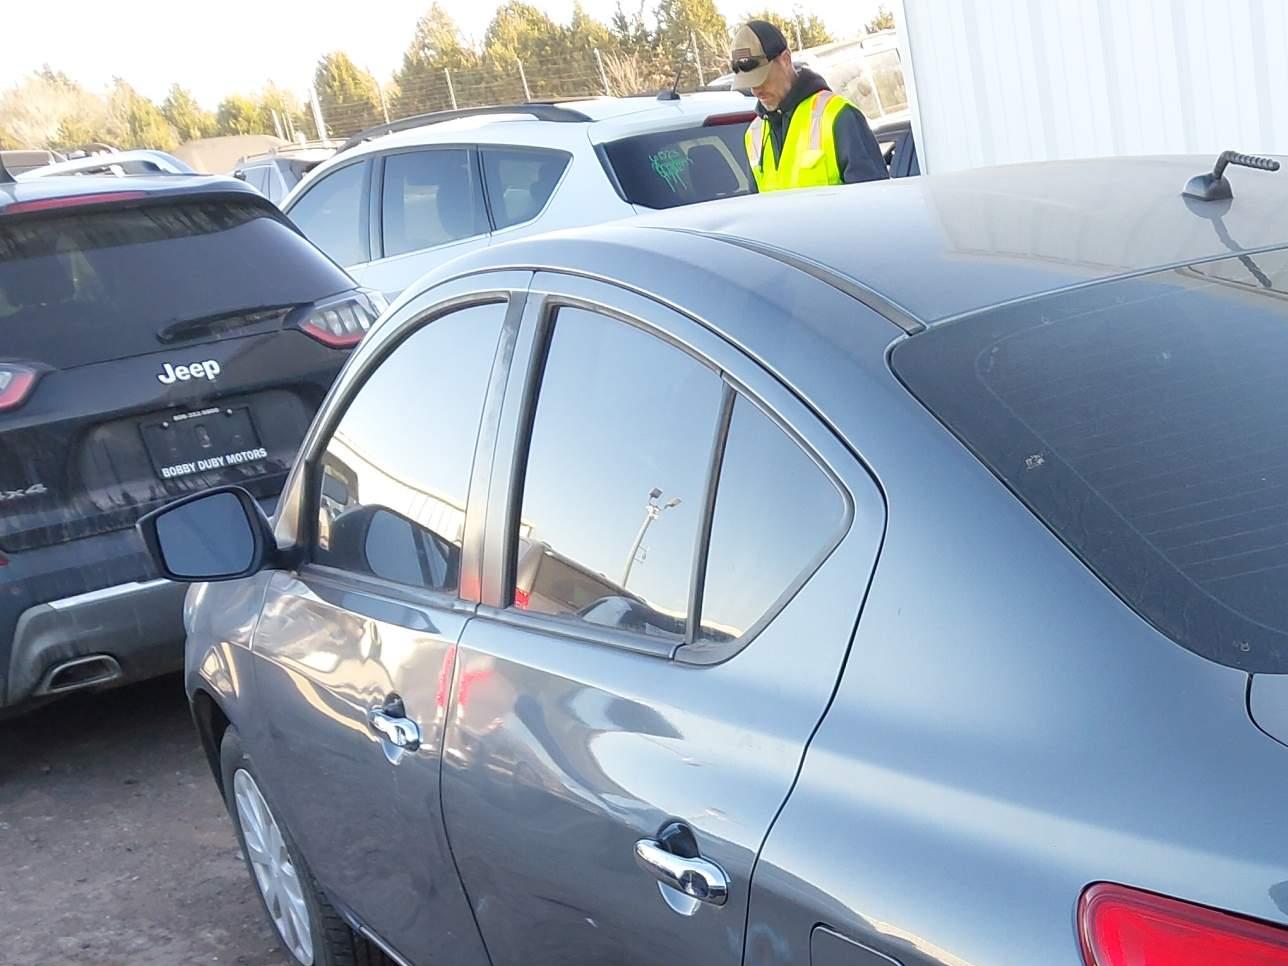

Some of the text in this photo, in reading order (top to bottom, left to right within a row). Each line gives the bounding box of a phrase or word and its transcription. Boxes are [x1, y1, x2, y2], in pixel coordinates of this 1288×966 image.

[158, 359, 220, 384] Jeep
[161, 447, 268, 478] BOBBY DUBY MOTORS
